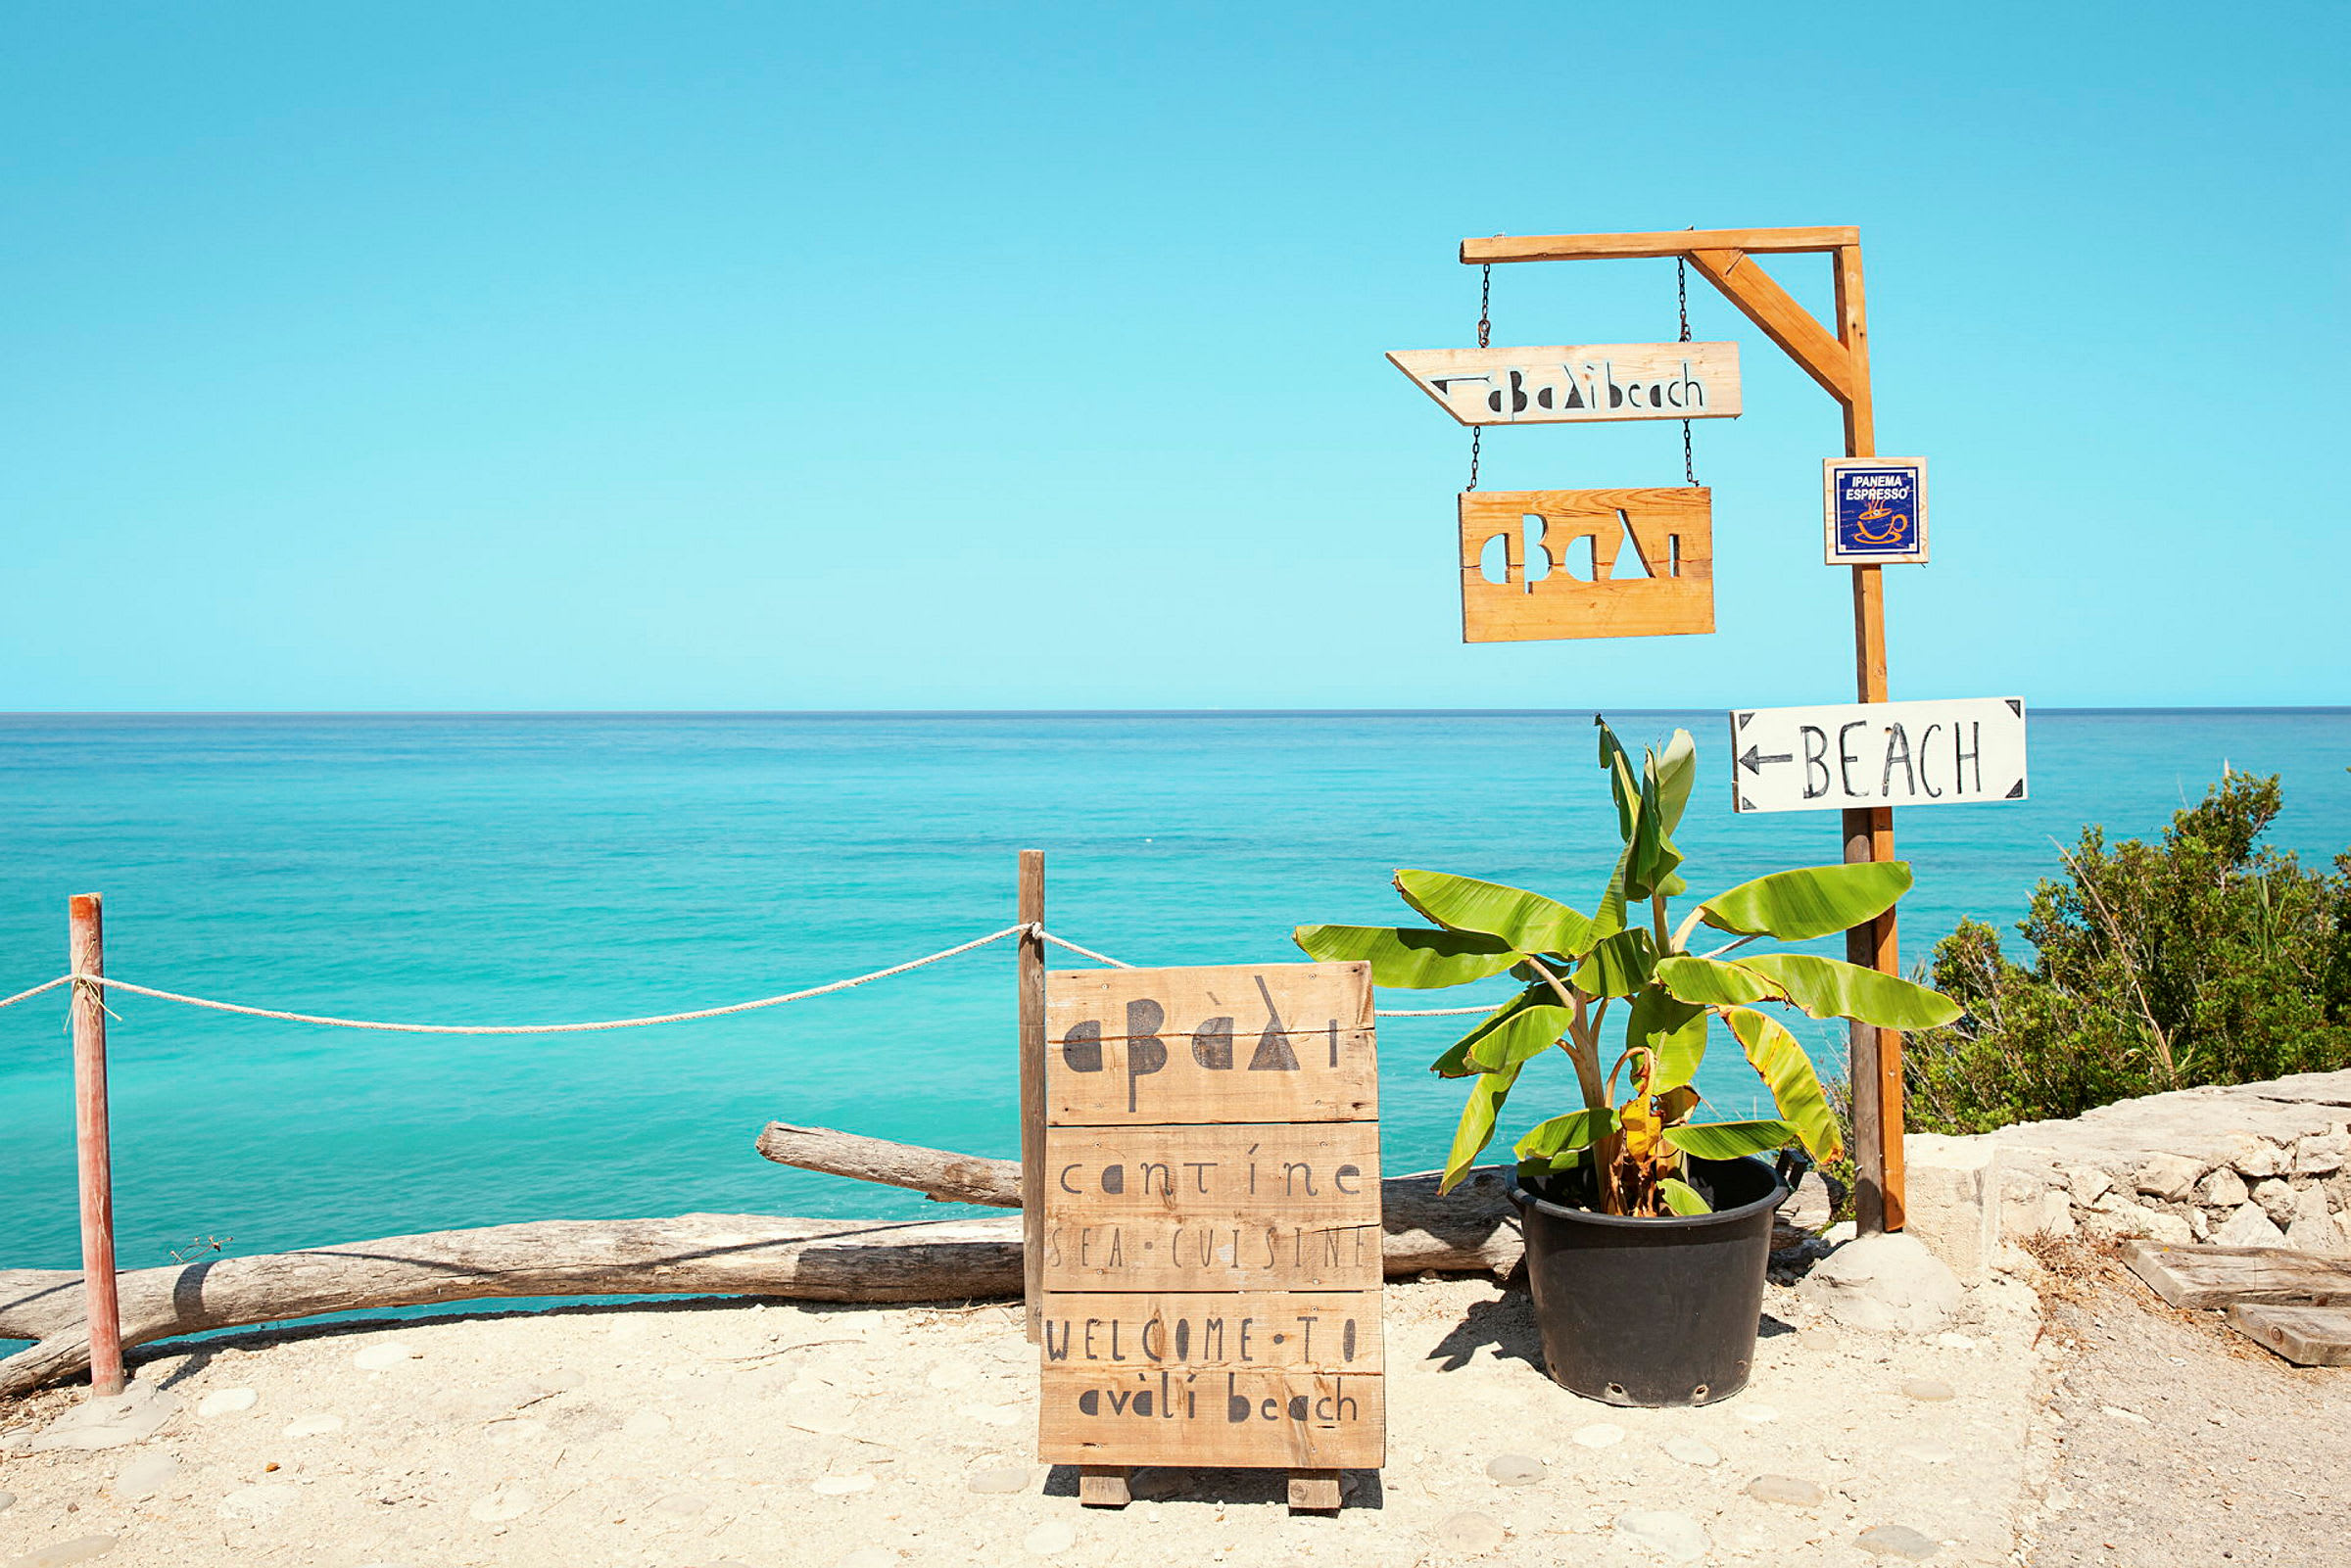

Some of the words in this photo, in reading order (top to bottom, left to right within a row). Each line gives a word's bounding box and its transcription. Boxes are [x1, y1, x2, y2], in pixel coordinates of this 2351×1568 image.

[1846, 488, 1908, 500] ESPRESSO
[1851, 475, 1902, 488] IPANEMA
[1799, 720, 1982, 799] BEACH
[1045, 1317, 1254, 1362] WELCOME
[1296, 1316, 1357, 1363] TO
[1227, 1371, 1358, 1423] beach
